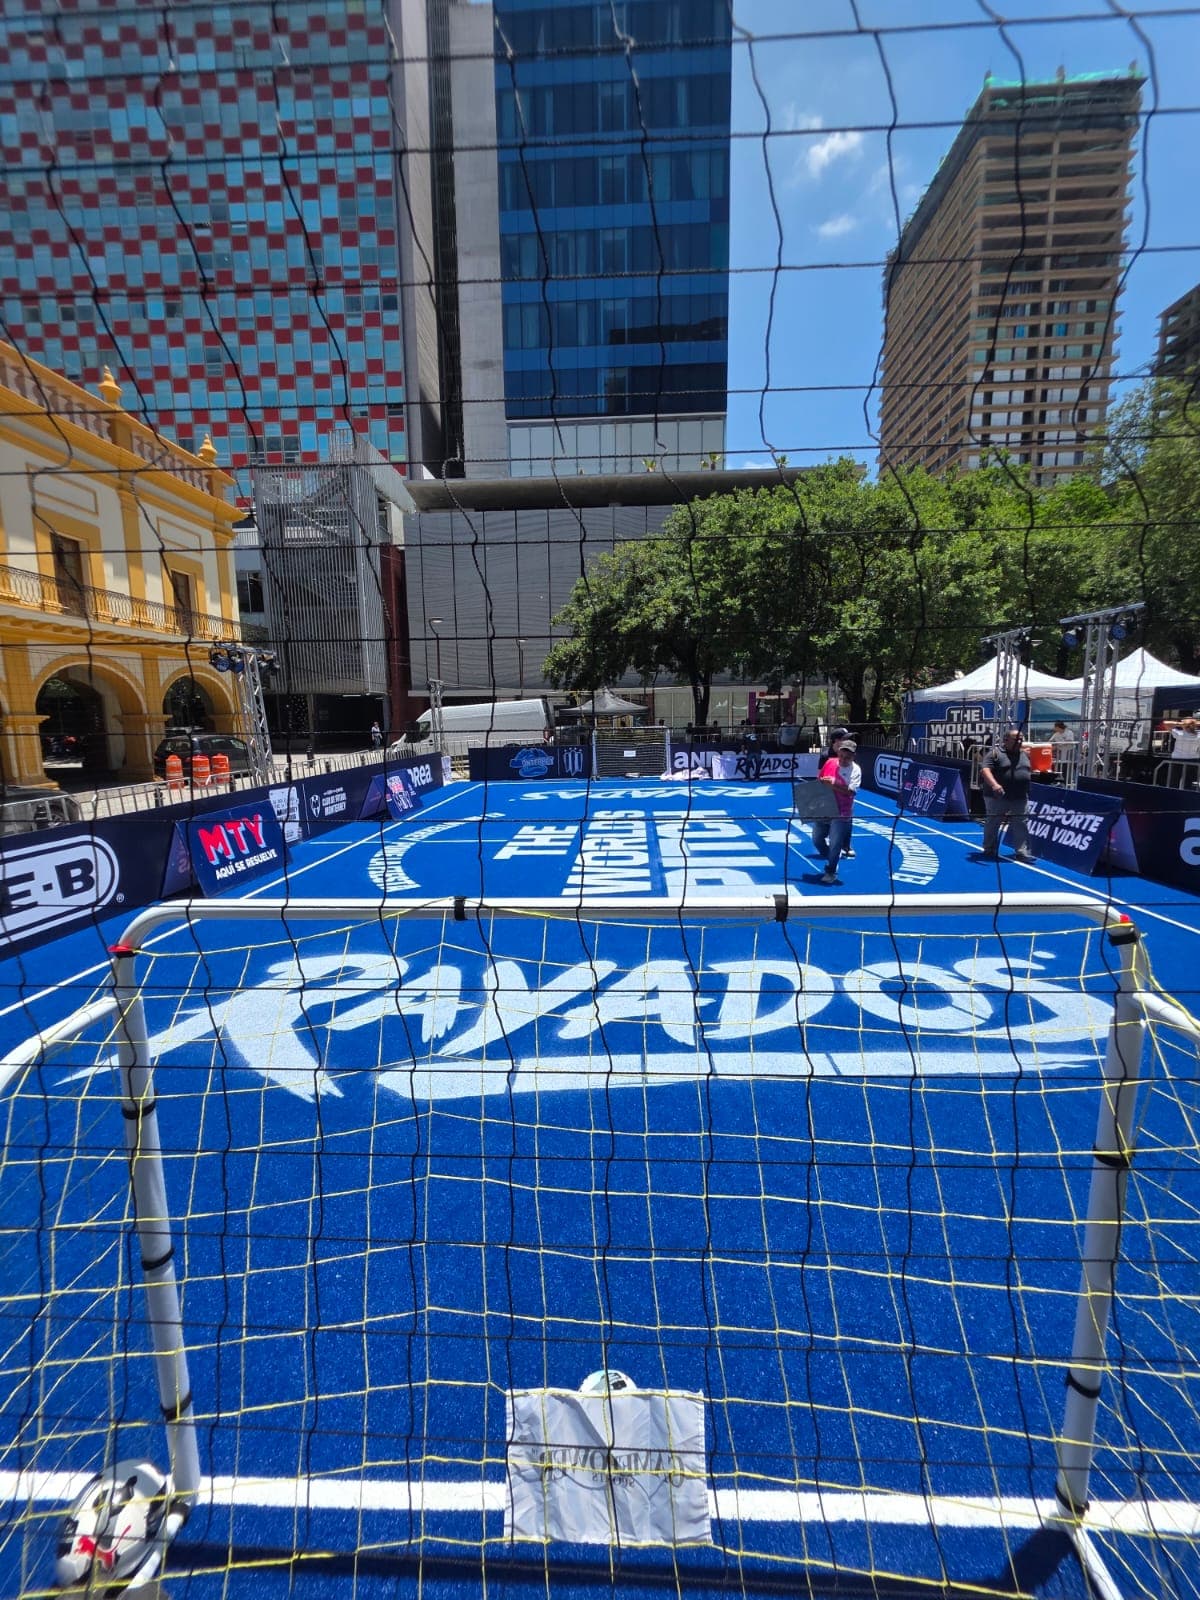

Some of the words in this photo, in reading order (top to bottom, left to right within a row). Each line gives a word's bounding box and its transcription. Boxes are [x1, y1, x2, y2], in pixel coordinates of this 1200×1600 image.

[950, 709, 981, 722] THE
[1026, 819, 1051, 839] ALVA
[1052, 826, 1093, 851] VIDAS
[1038, 804, 1104, 833] DEPORTE
[198, 814, 268, 865] MTY
[492, 825, 579, 860] THE
[652, 810, 804, 898] PITCH
[215, 861, 235, 880] AQUÍ
[235, 860, 245, 873] SE
[244, 849, 278, 870] RESUELVE
[62, 950, 1116, 1101] RAYADOS
